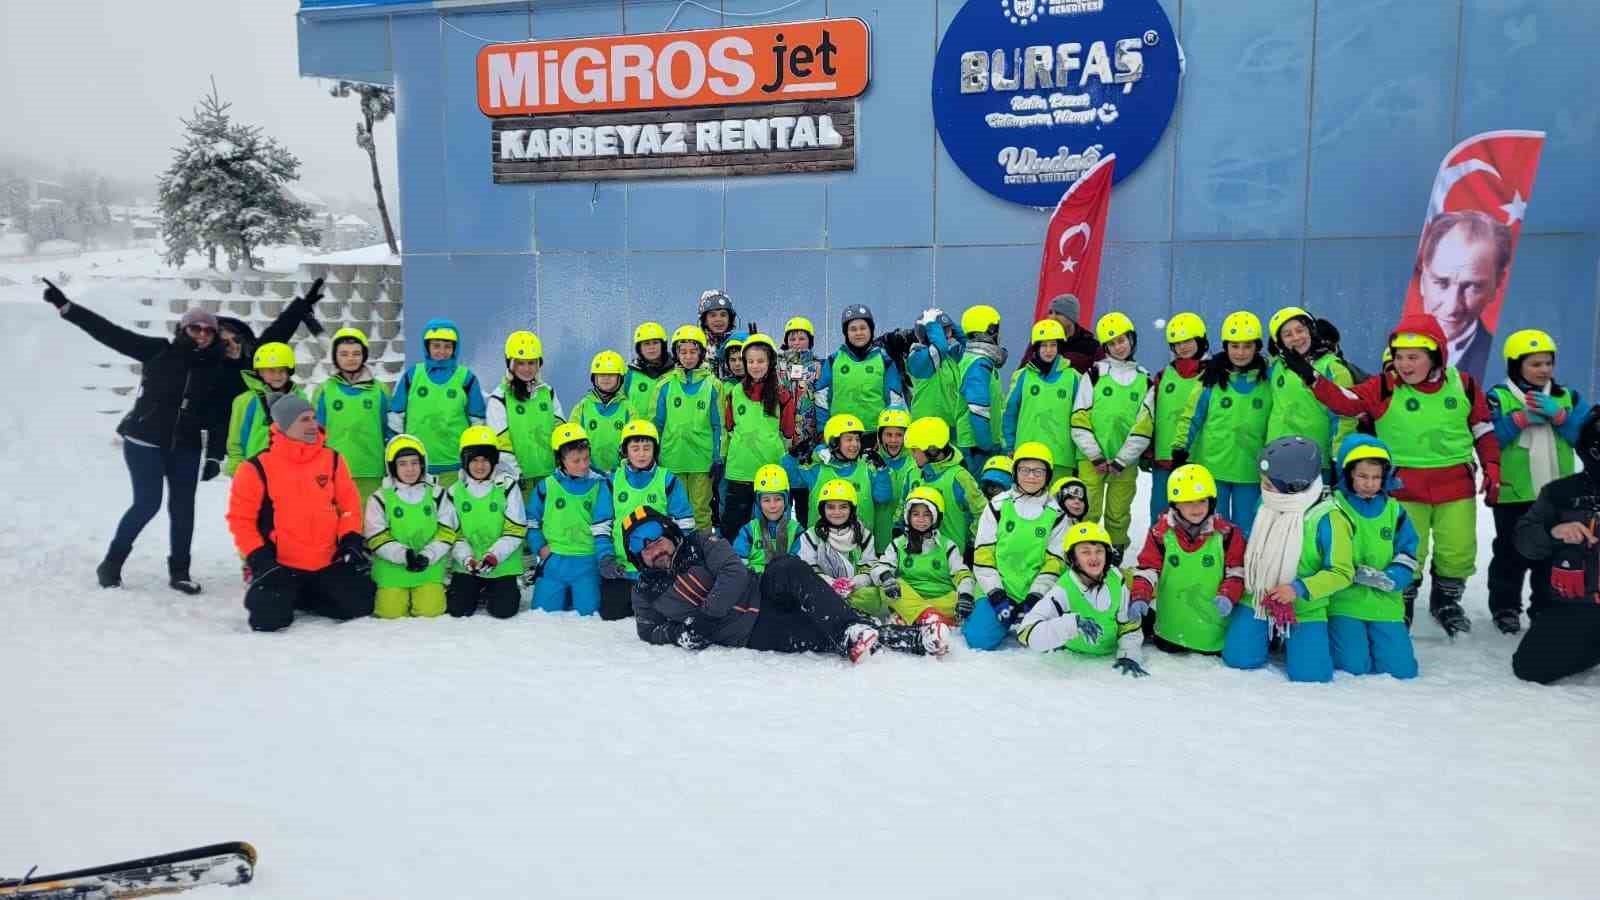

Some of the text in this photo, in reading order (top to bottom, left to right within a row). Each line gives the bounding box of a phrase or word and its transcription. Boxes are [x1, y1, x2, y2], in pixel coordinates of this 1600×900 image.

[761, 29, 837, 93] jet
[960, 38, 1143, 94] BURFAŞ
[501, 115, 843, 160] KARBEYAZ RENTAL
